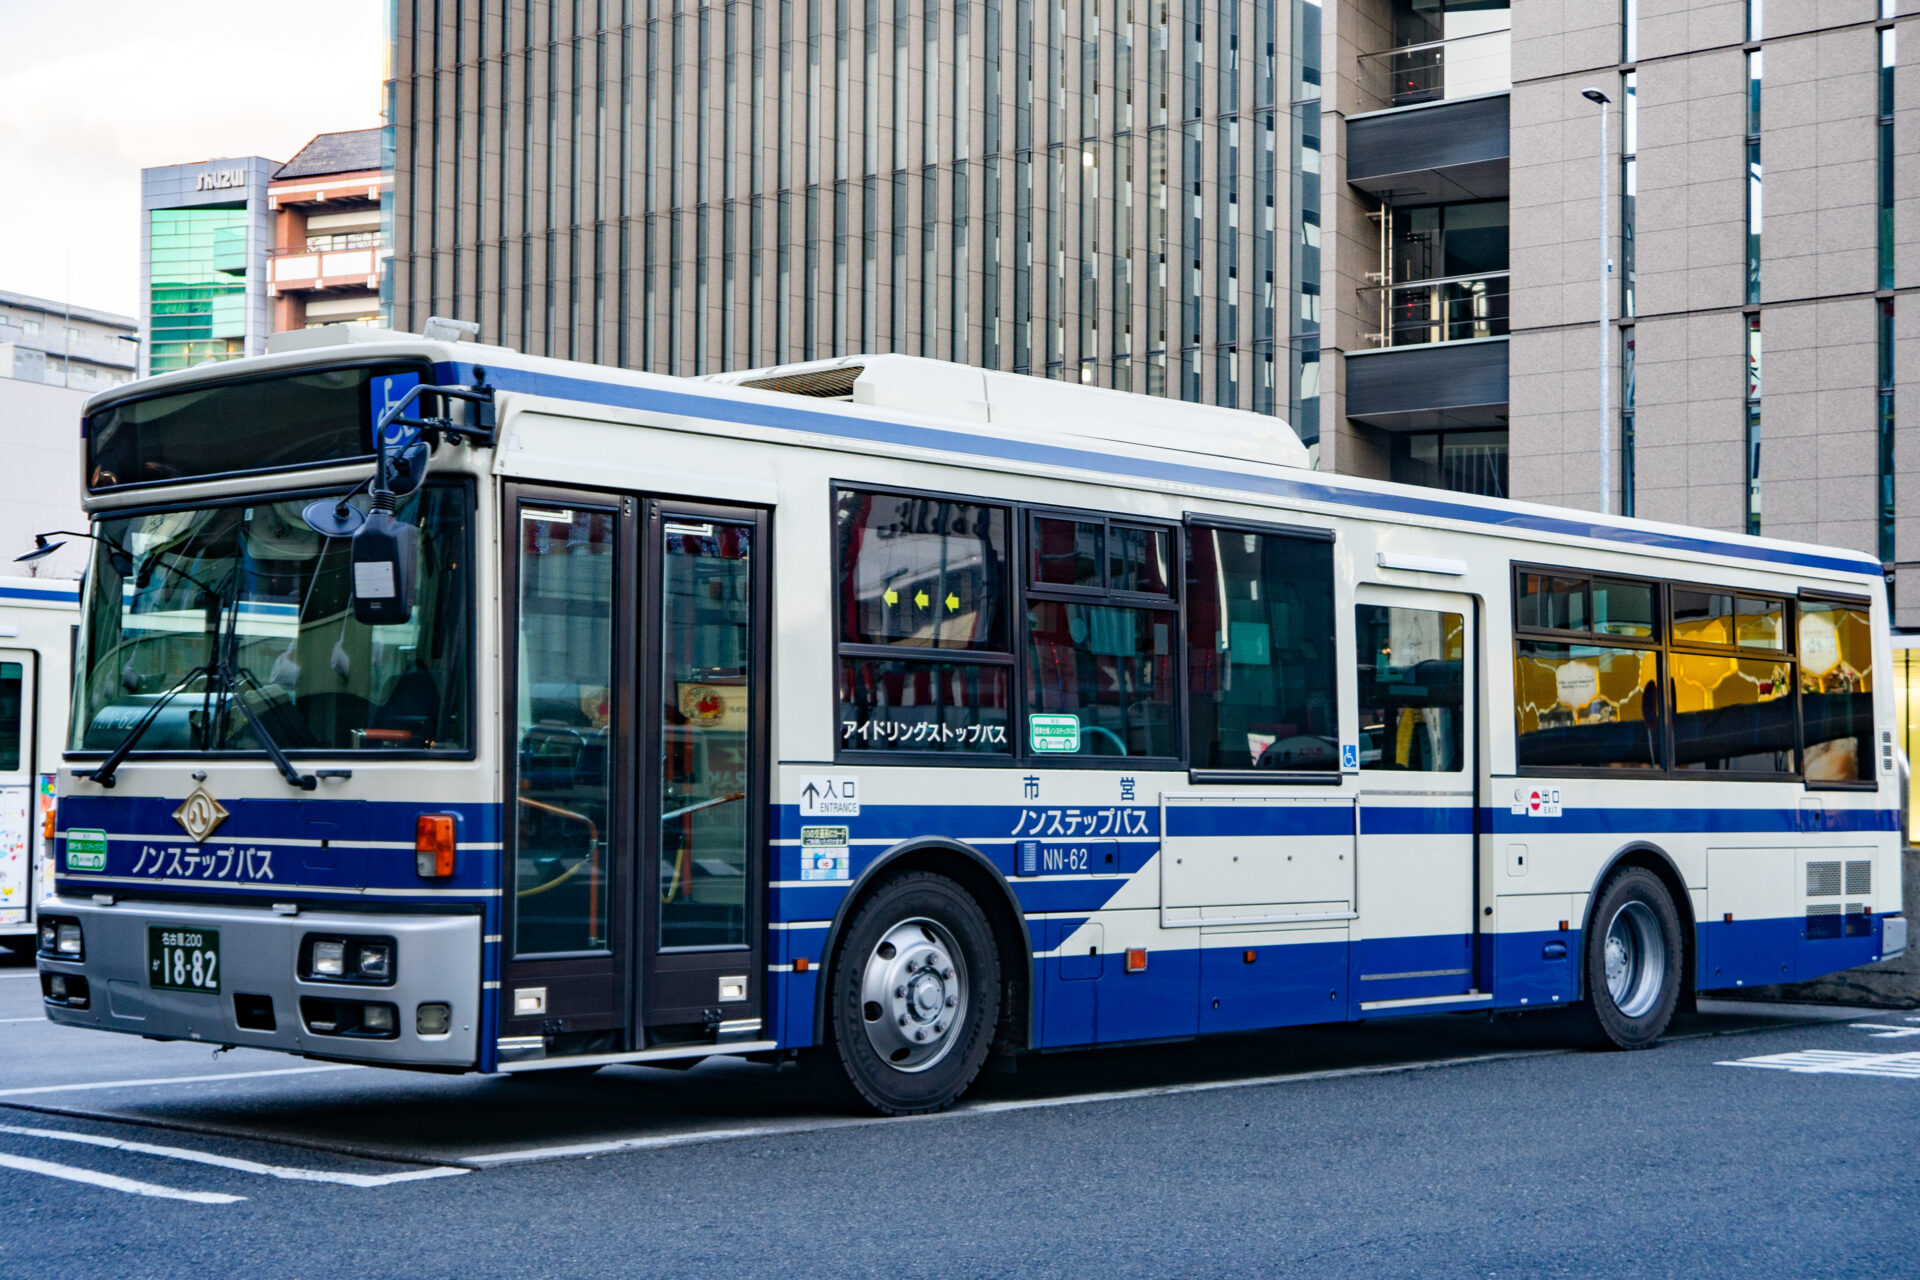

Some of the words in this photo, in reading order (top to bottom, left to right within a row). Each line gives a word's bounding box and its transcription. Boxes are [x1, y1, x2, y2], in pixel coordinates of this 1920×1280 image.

[842, 720, 1007, 744] アイドリングストップバス
[823, 780, 855, 799] 入口
[1023, 774, 1041, 800] 市
[1120, 776, 1136, 801] 営
[1541, 789, 1560, 803] 出口
[820, 802, 857, 813] ENTRANCE
[1010, 807, 1149, 836] ノンステップバス
[132, 845, 275, 880] ノンステップバス
[1043, 848, 1088, 871] NN-62
[163, 947, 217, 988] 18-82
